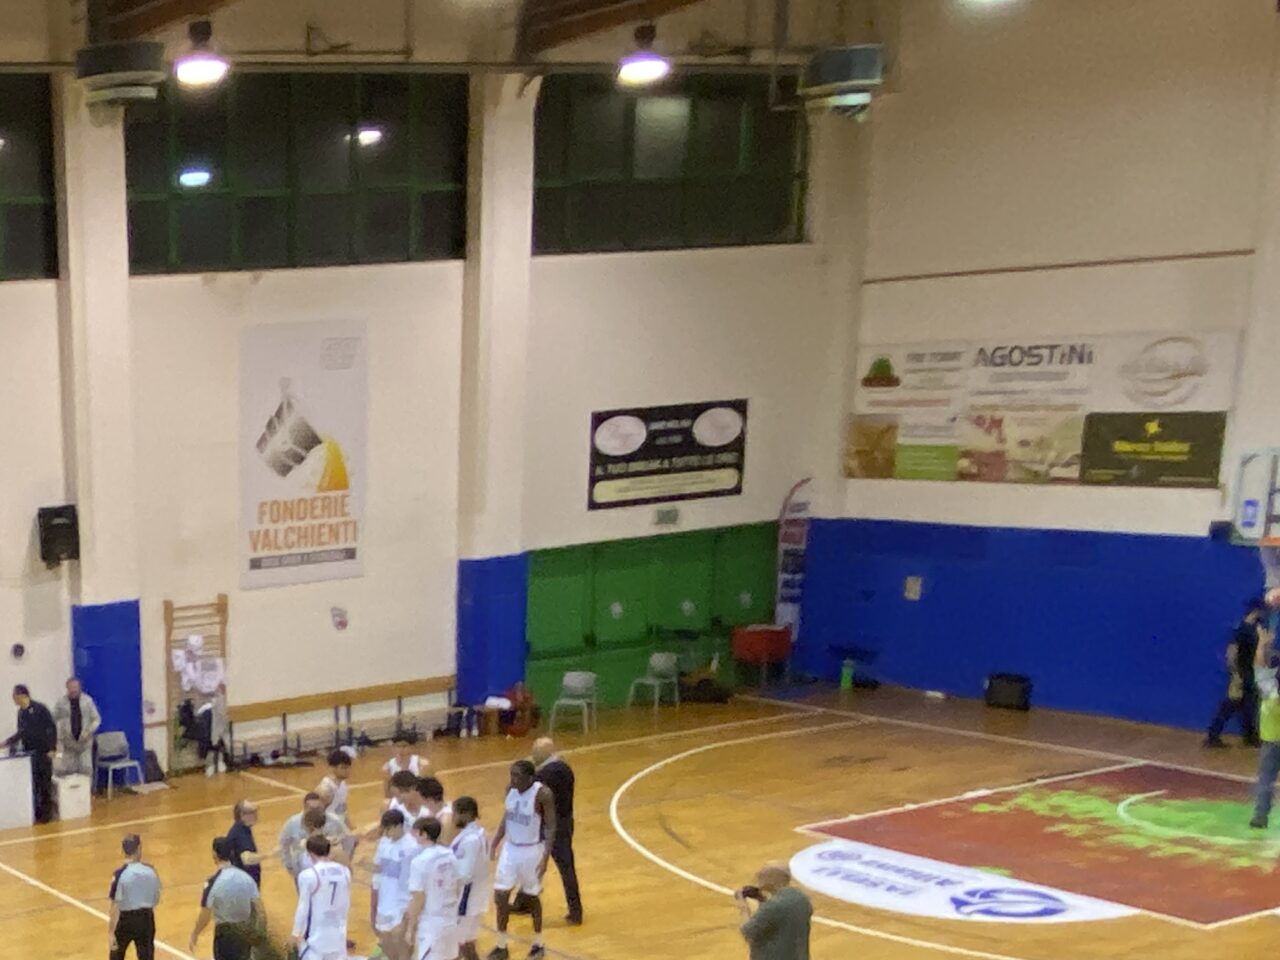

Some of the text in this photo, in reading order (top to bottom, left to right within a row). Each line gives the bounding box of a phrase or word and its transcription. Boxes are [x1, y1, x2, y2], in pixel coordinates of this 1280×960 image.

[257, 495, 350, 524] FONDERIE
[249, 520, 357, 553] VALCHIENTI
[328, 880, 338, 906] 7
